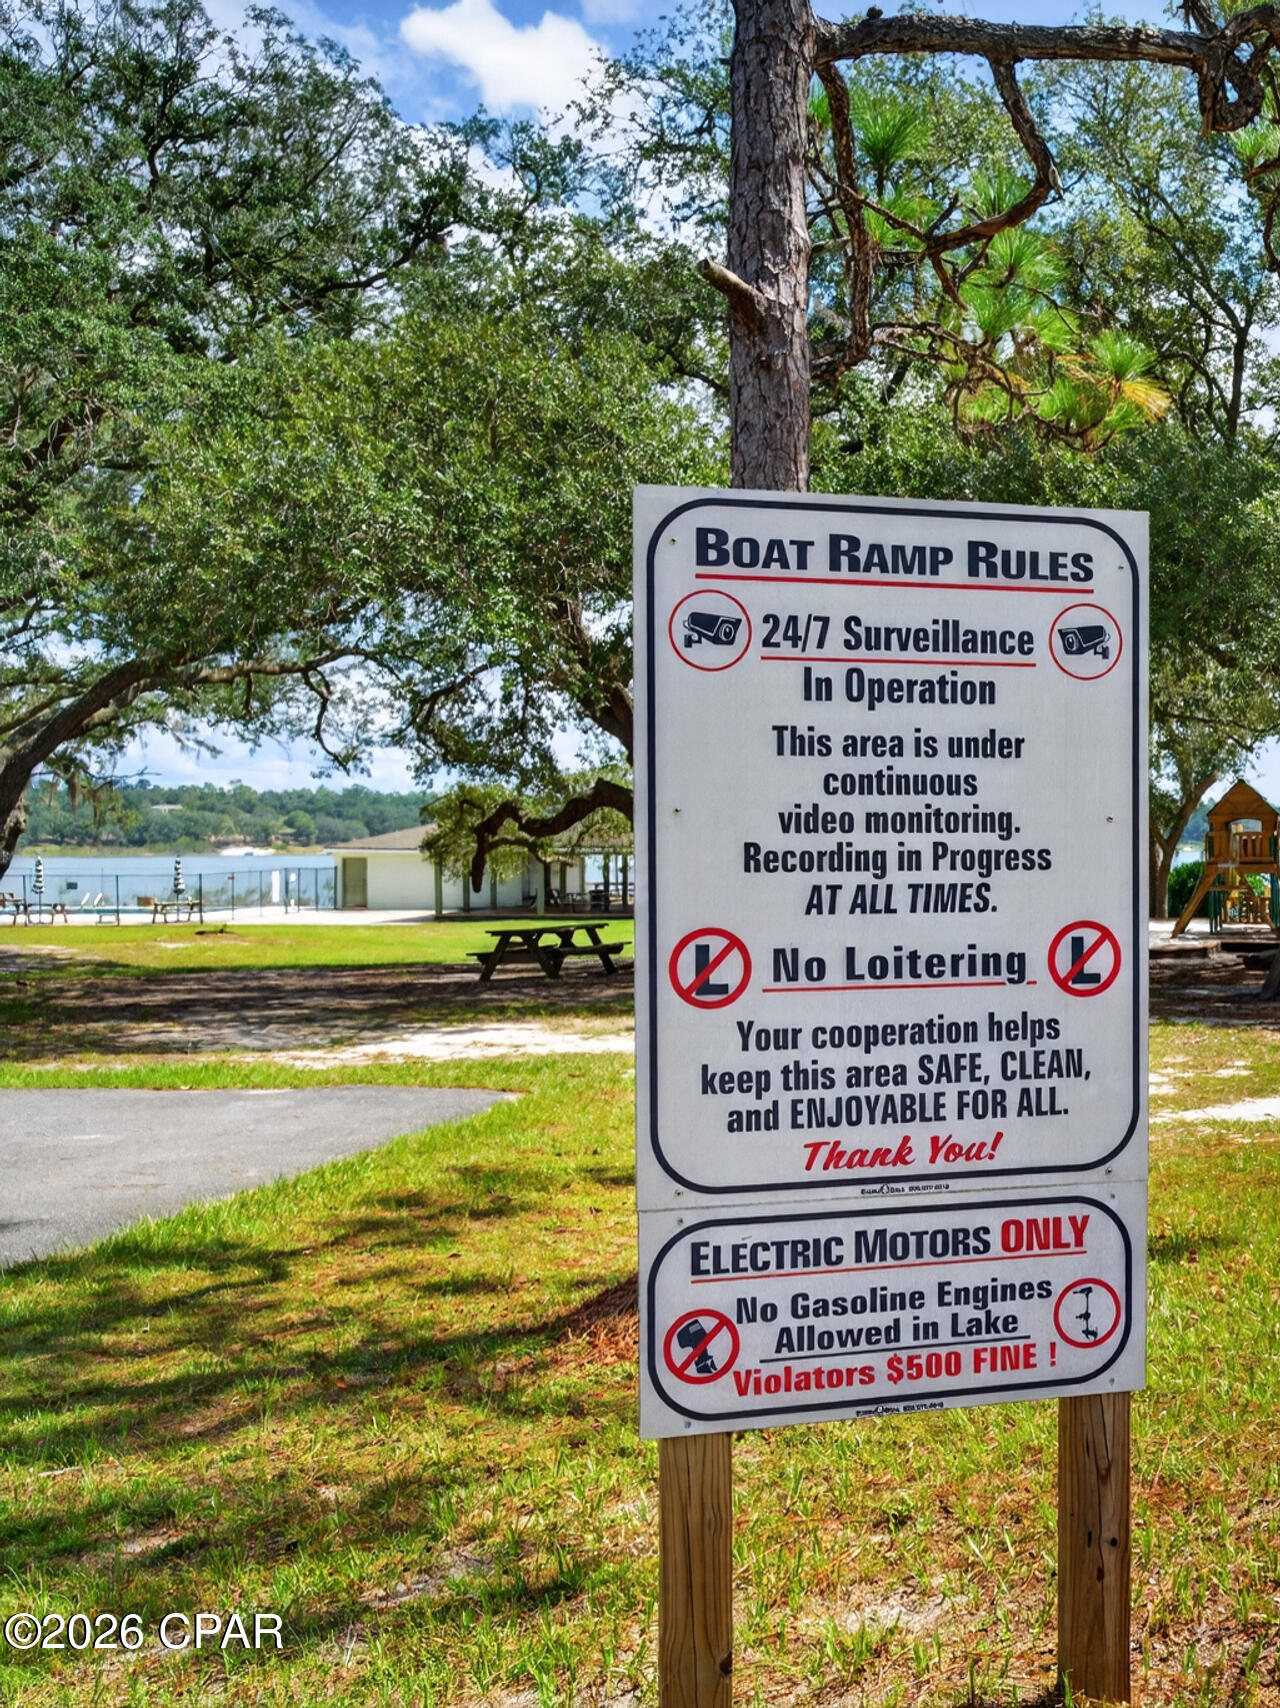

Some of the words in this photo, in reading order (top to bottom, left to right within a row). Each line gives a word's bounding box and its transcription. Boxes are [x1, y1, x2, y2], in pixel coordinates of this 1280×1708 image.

[696, 528, 814, 568] BOAT
[829, 534, 953, 576] RAMP
[967, 540, 1094, 583] RULES
[761, 614, 831, 650] 24/7
[843, 615, 1034, 656] Surveillance
[803, 667, 832, 702] In
[846, 668, 996, 710] Operation
[772, 725, 832, 757] This
[843, 732, 903, 758] area
[914, 729, 938, 757] is
[948, 730, 1025, 759] under
[823, 766, 978, 796] continuous
[779, 804, 854, 834] video
[865, 804, 1020, 840] monitoring.
[744, 842, 887, 878] Recording
[898, 843, 921, 871] in
[932, 843, 1051, 878] Progress
[805, 885, 842, 915] AT
[849, 883, 898, 914] ALL
[908, 883, 997, 913] TIMES.
[695, 943, 728, 995] L
[773, 947, 826, 983] No
[846, 944, 1027, 984] Loitering
[1070, 936, 1100, 985] L
[737, 1020, 801, 1051] Your
[812, 1013, 978, 1053] cooperation
[988, 1011, 1060, 1044] helps
[701, 1064, 770, 1099] keep
[781, 1060, 836, 1091] this
[846, 1062, 907, 1088] area
[918, 1054, 989, 1086] SAFE,
[1001, 1048, 1091, 1081] CLEAN,
[727, 1100, 779, 1133] and
[791, 1092, 947, 1129] ENJOYABLE
[957, 1089, 1007, 1120] FOR
[1017, 1087, 1068, 1117] ALL.
[803, 1140, 916, 1171] Thank
[929, 1132, 1003, 1165] You!
[690, 1236, 844, 1276] ELECTRIC
[855, 1224, 990, 1264] MOTORS
[1000, 1215, 1090, 1253] ONLY
[736, 1297, 778, 1323] No
[791, 1285, 925, 1319] Gasoline
[938, 1278, 1052, 1309] Engines
[774, 1321, 901, 1355] Allowed
[913, 1316, 937, 1340] in
[950, 1309, 1018, 1338] Lake
[732, 1361, 875, 1397] Violators
[886, 1353, 961, 1385] $500
[973, 1344, 1037, 1374] FINE
